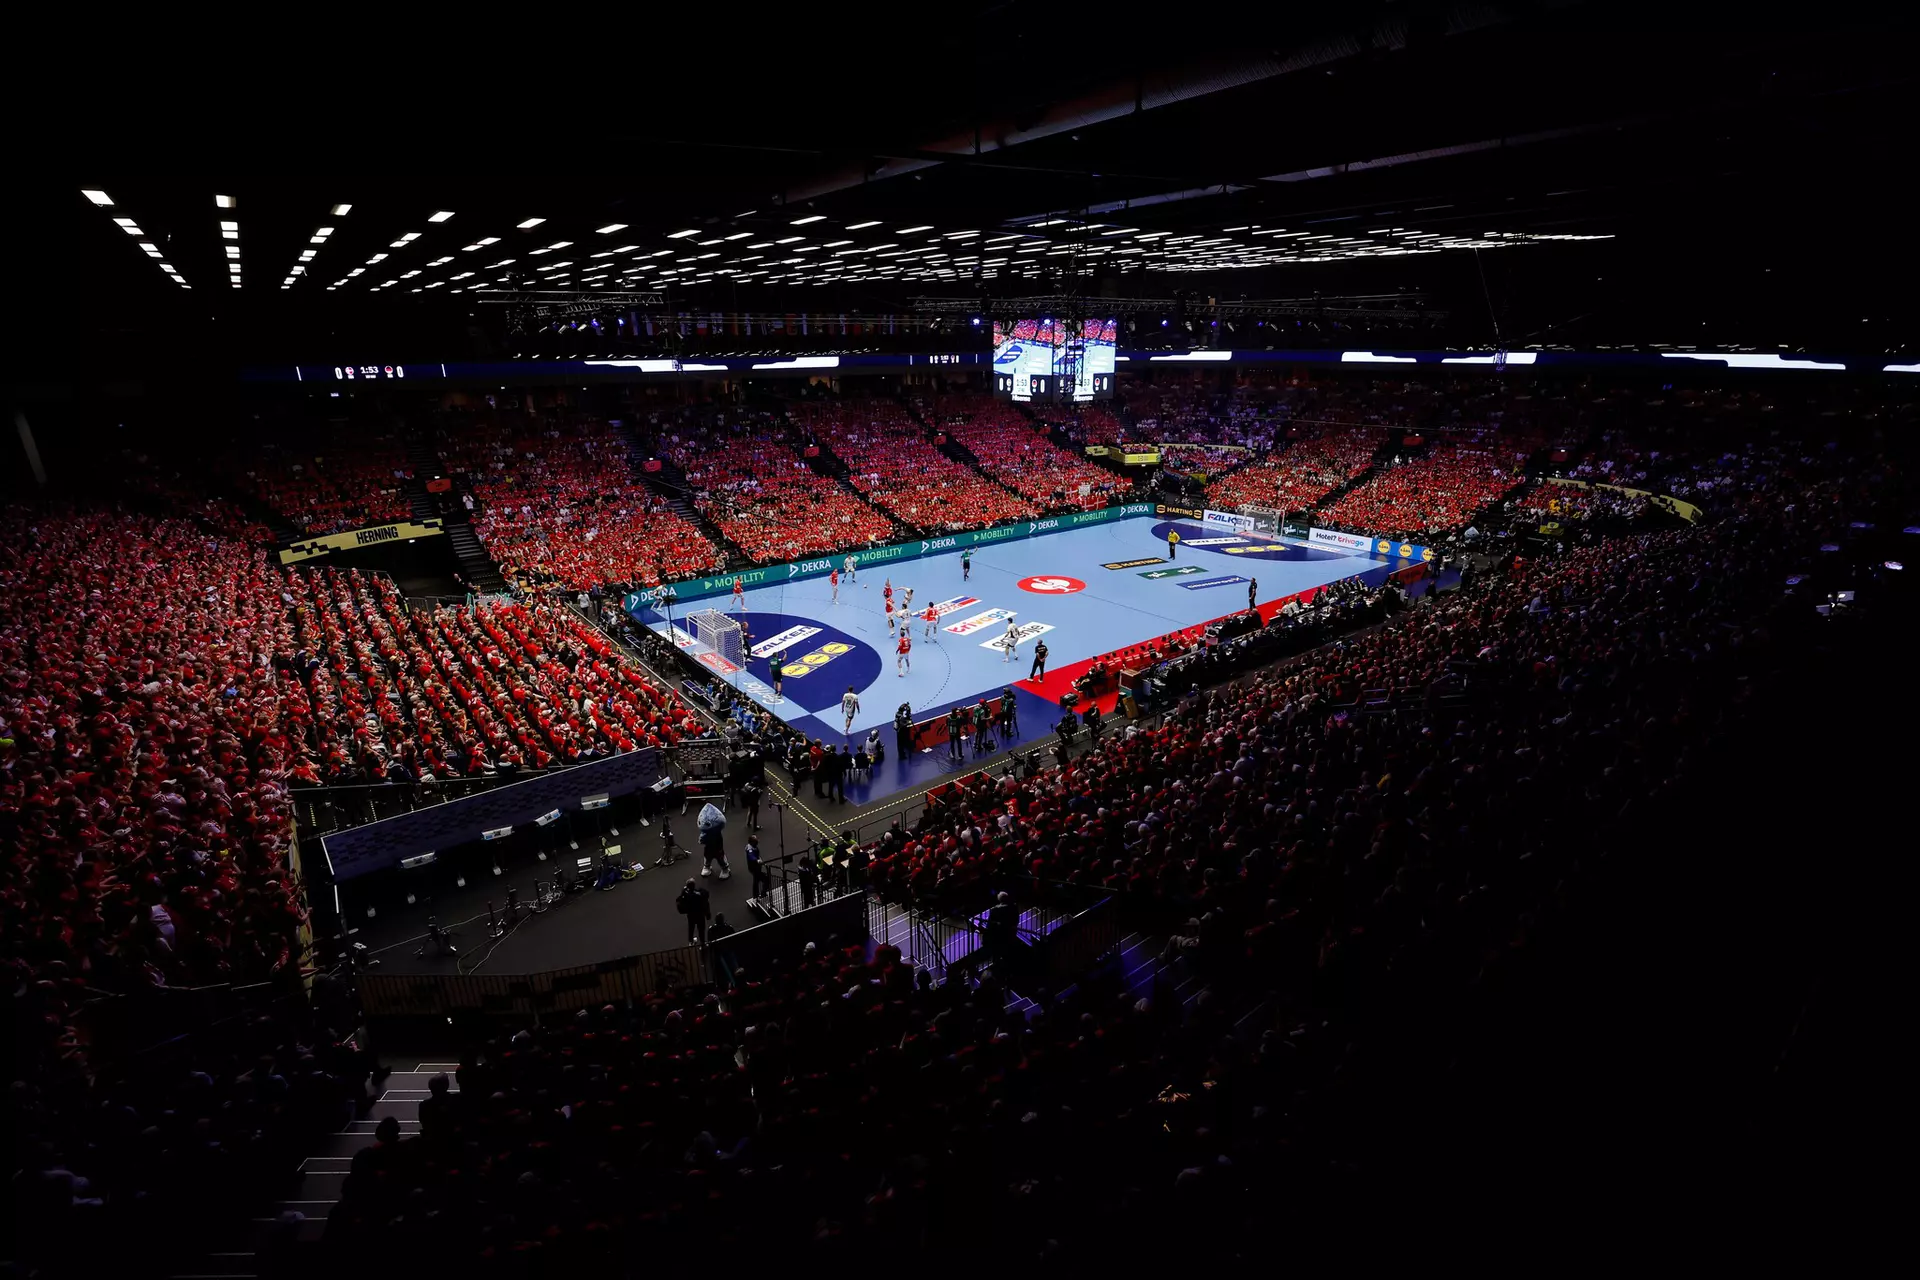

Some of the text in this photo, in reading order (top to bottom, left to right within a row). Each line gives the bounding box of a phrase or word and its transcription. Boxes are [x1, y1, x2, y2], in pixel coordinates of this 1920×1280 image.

[335, 365, 404, 380] 0 1:53 0
[1127, 505, 1149, 514] DEKRA
[1166, 506, 1193, 516] HARTING
[1079, 511, 1108, 523] MOBILITY
[1038, 519, 1059, 530] DEKRA
[355, 526, 399, 545] HERNING
[980, 527, 1015, 541] MOBILITY
[931, 537, 956, 550] DEKRA
[1337, 536, 1365, 547] trivago
[861, 547, 903, 562] MOBILITY
[801, 559, 832, 573] DEKRA
[640, 586, 677, 602] DERA
[947, 610, 1008, 633] trivago
[751, 626, 811, 655] FALKEN
